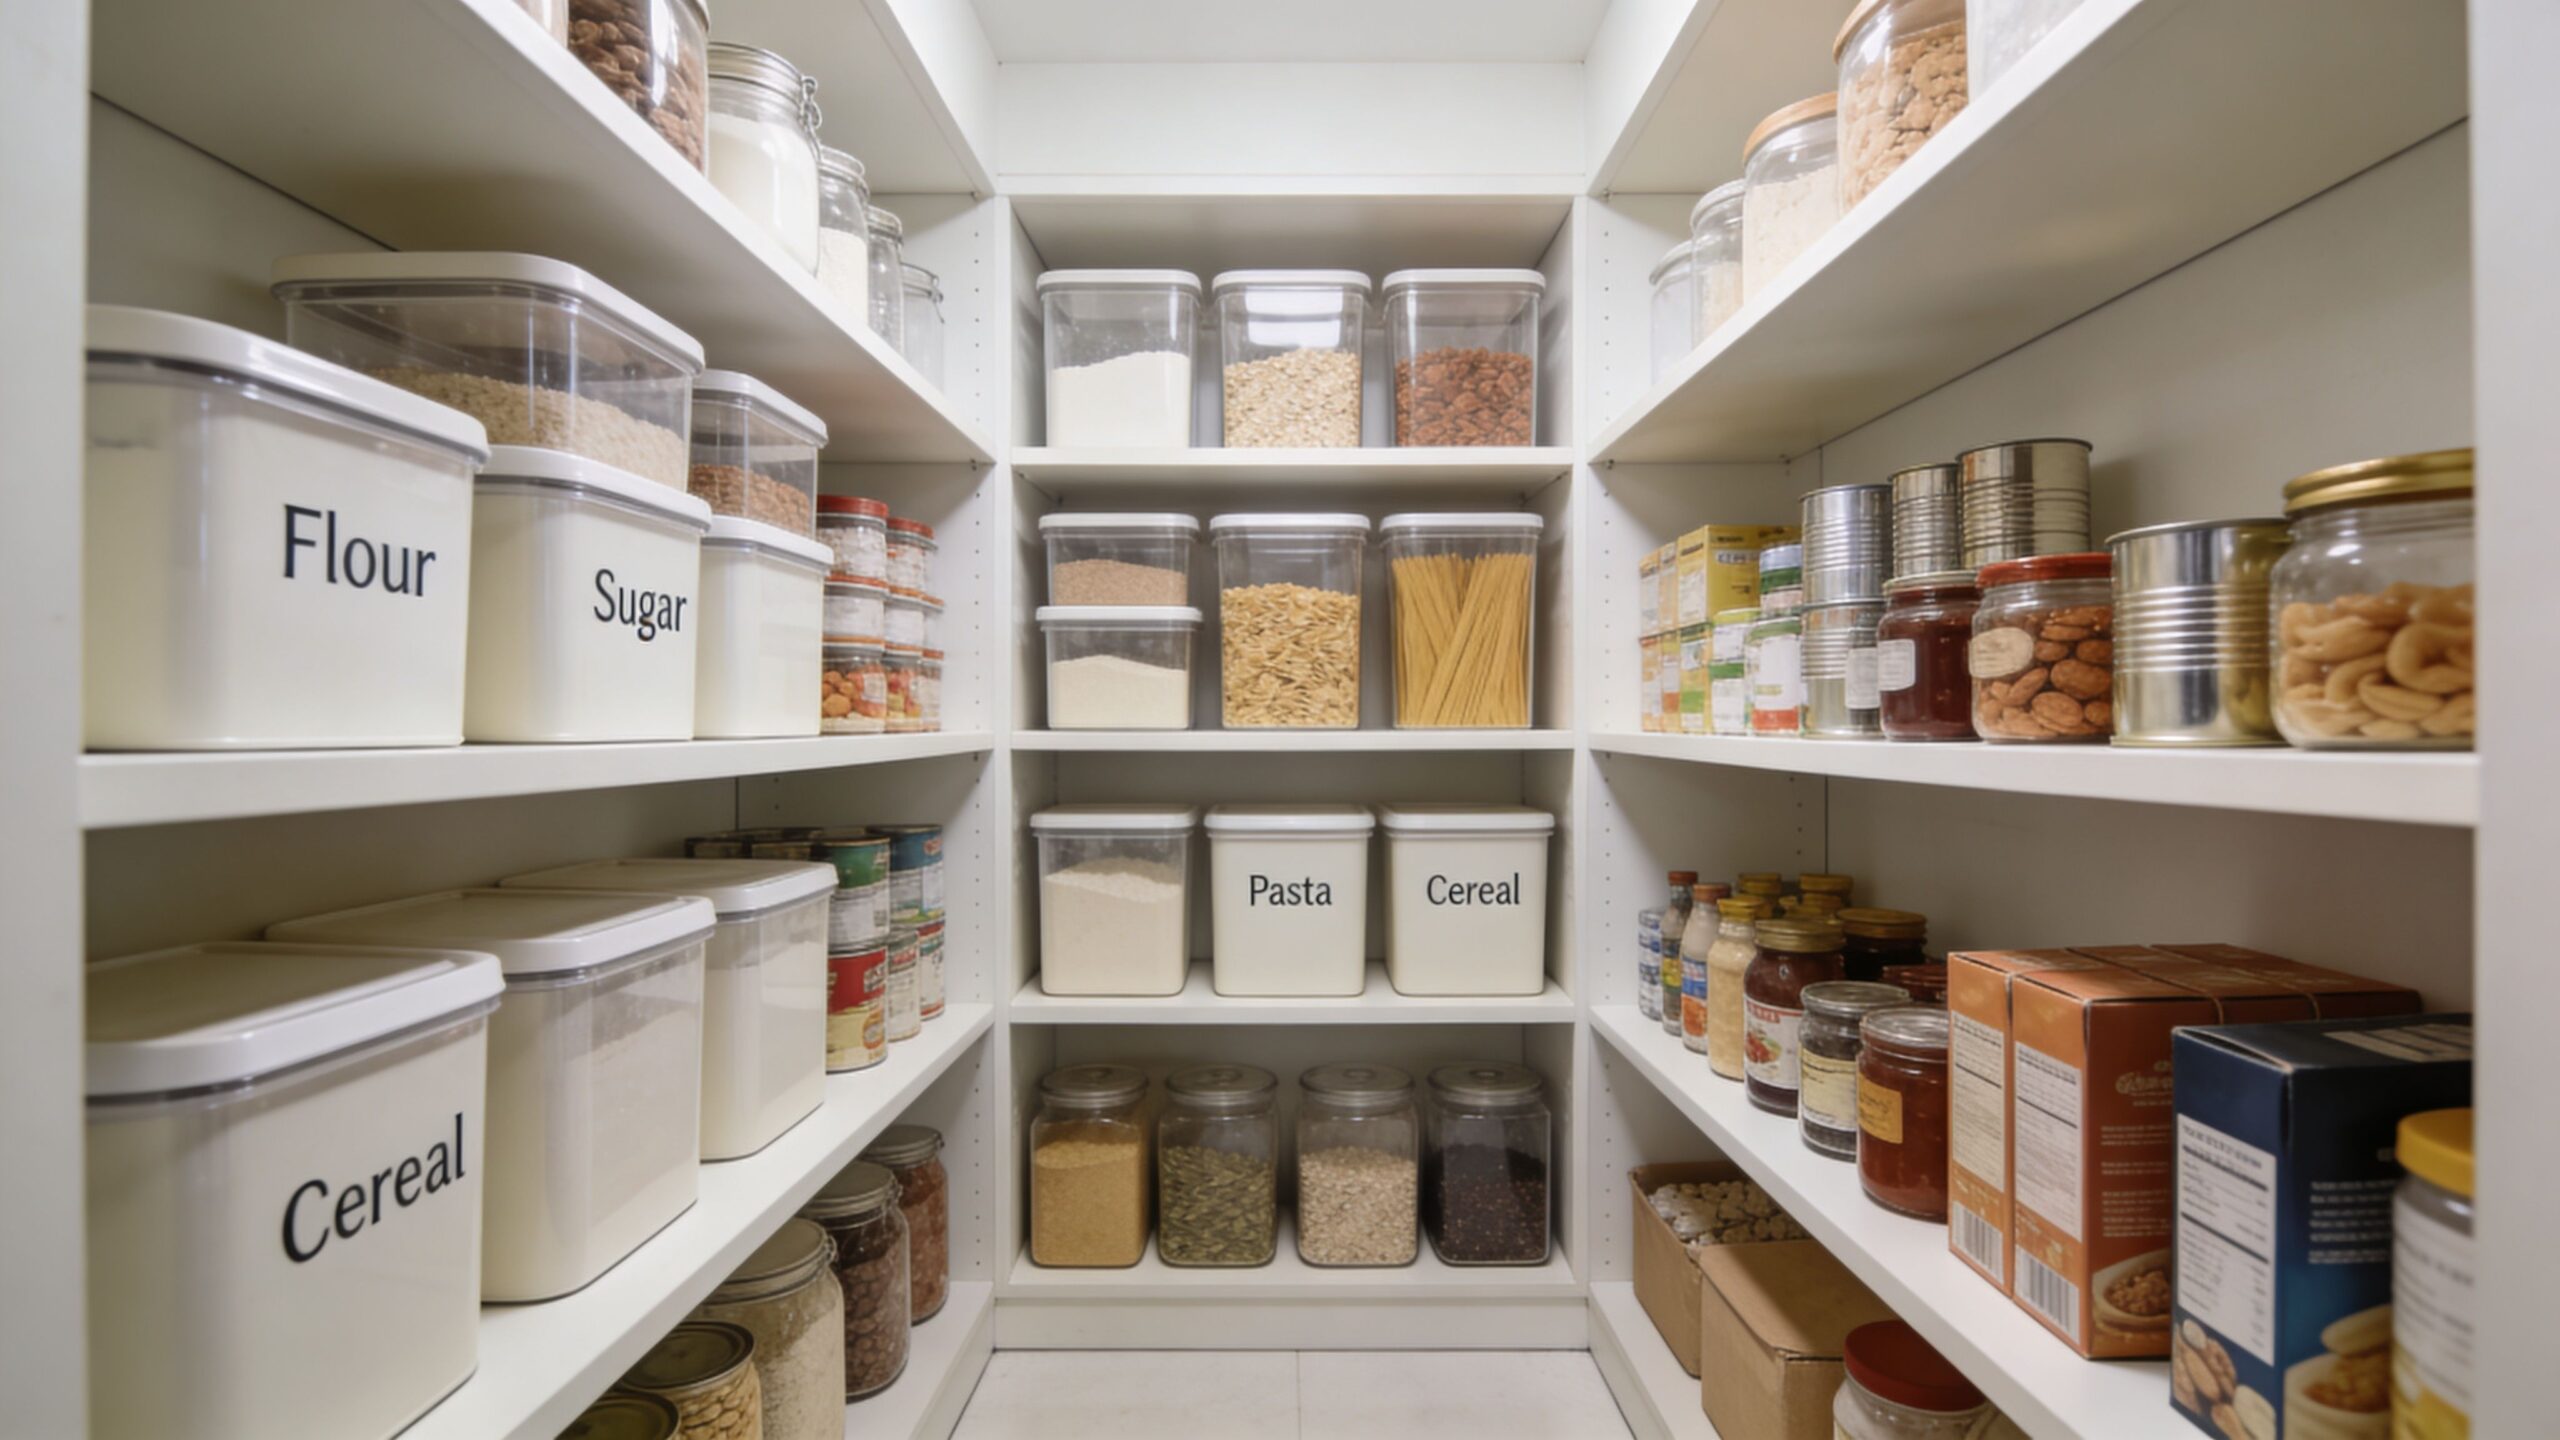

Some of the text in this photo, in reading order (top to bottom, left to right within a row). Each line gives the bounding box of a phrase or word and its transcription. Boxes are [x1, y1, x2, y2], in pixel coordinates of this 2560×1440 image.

[283, 504, 436, 597] Flour
[594, 569, 687, 642] Sugar
[1250, 874, 1332, 906] Pasta
[1427, 872, 1520, 905] Cereal
[281, 1112, 466, 1265] Cereal
